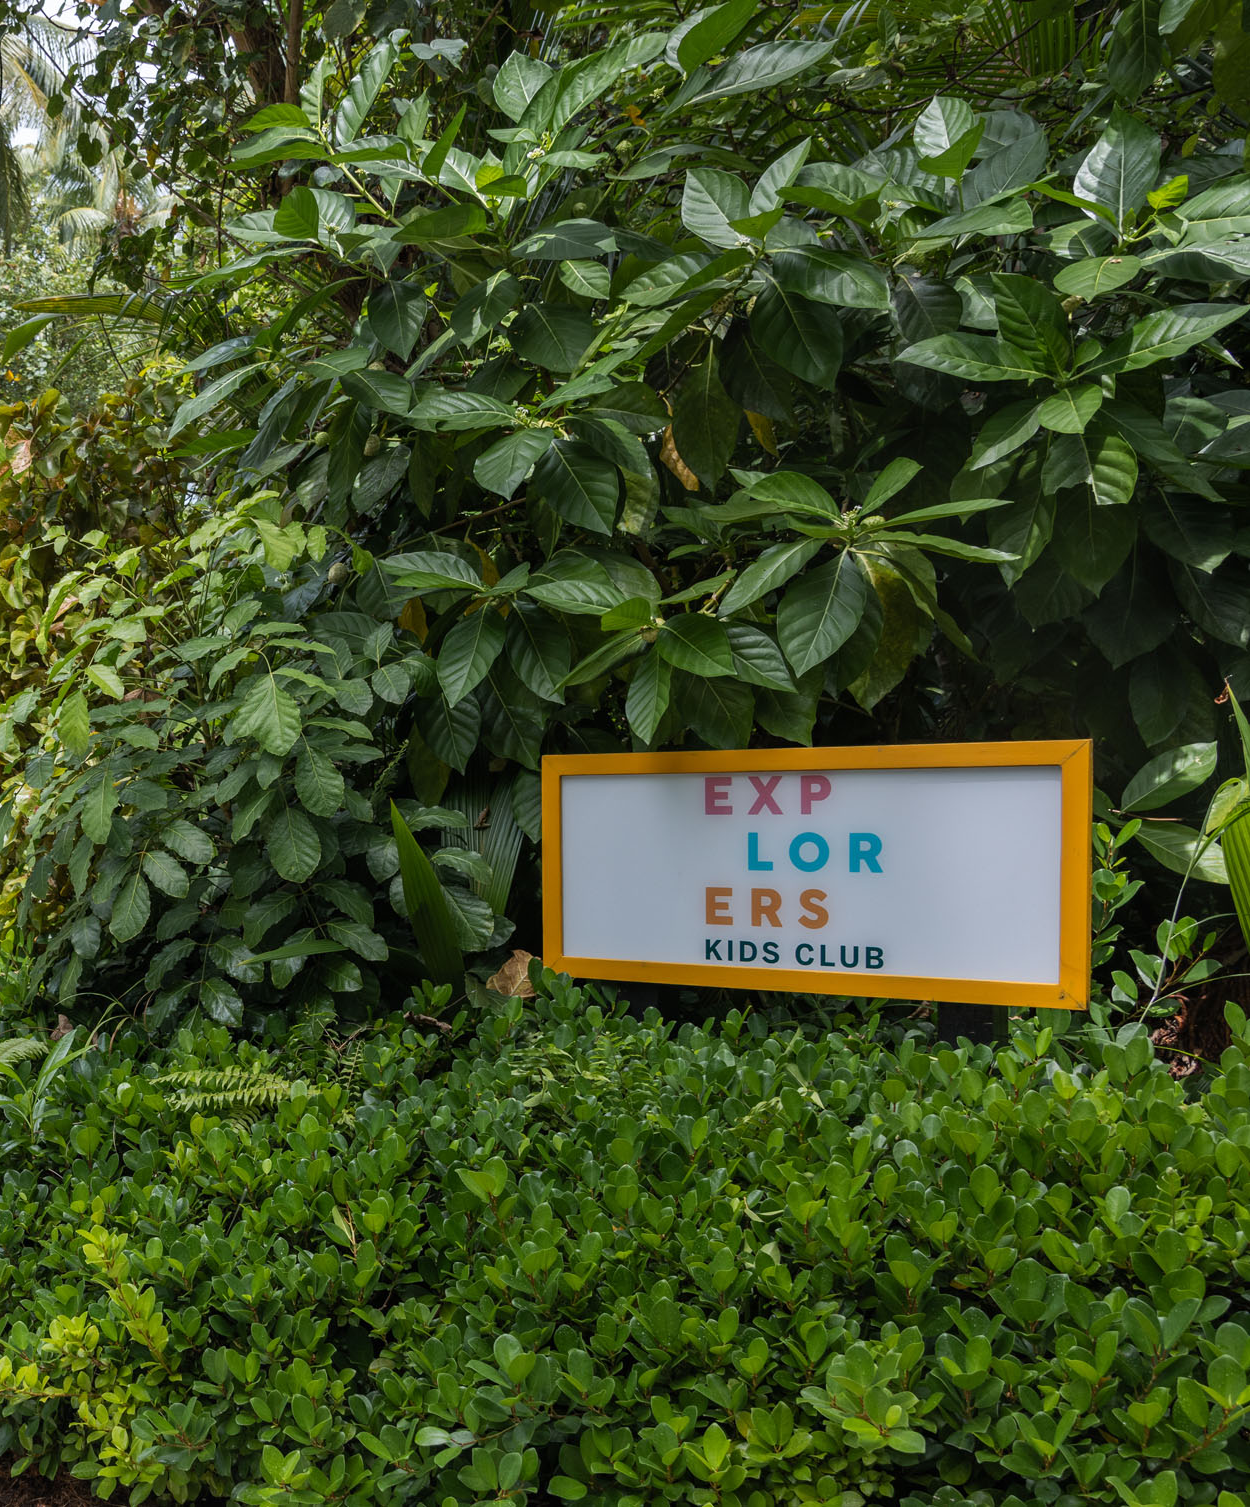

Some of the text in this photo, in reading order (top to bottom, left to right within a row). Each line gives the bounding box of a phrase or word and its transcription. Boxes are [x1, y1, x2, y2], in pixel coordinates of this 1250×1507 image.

[704, 775, 832, 815] EXP
[747, 831, 884, 874] LOR
[705, 886, 830, 930] ERS
[705, 938, 885, 969] KIDS CLUB
